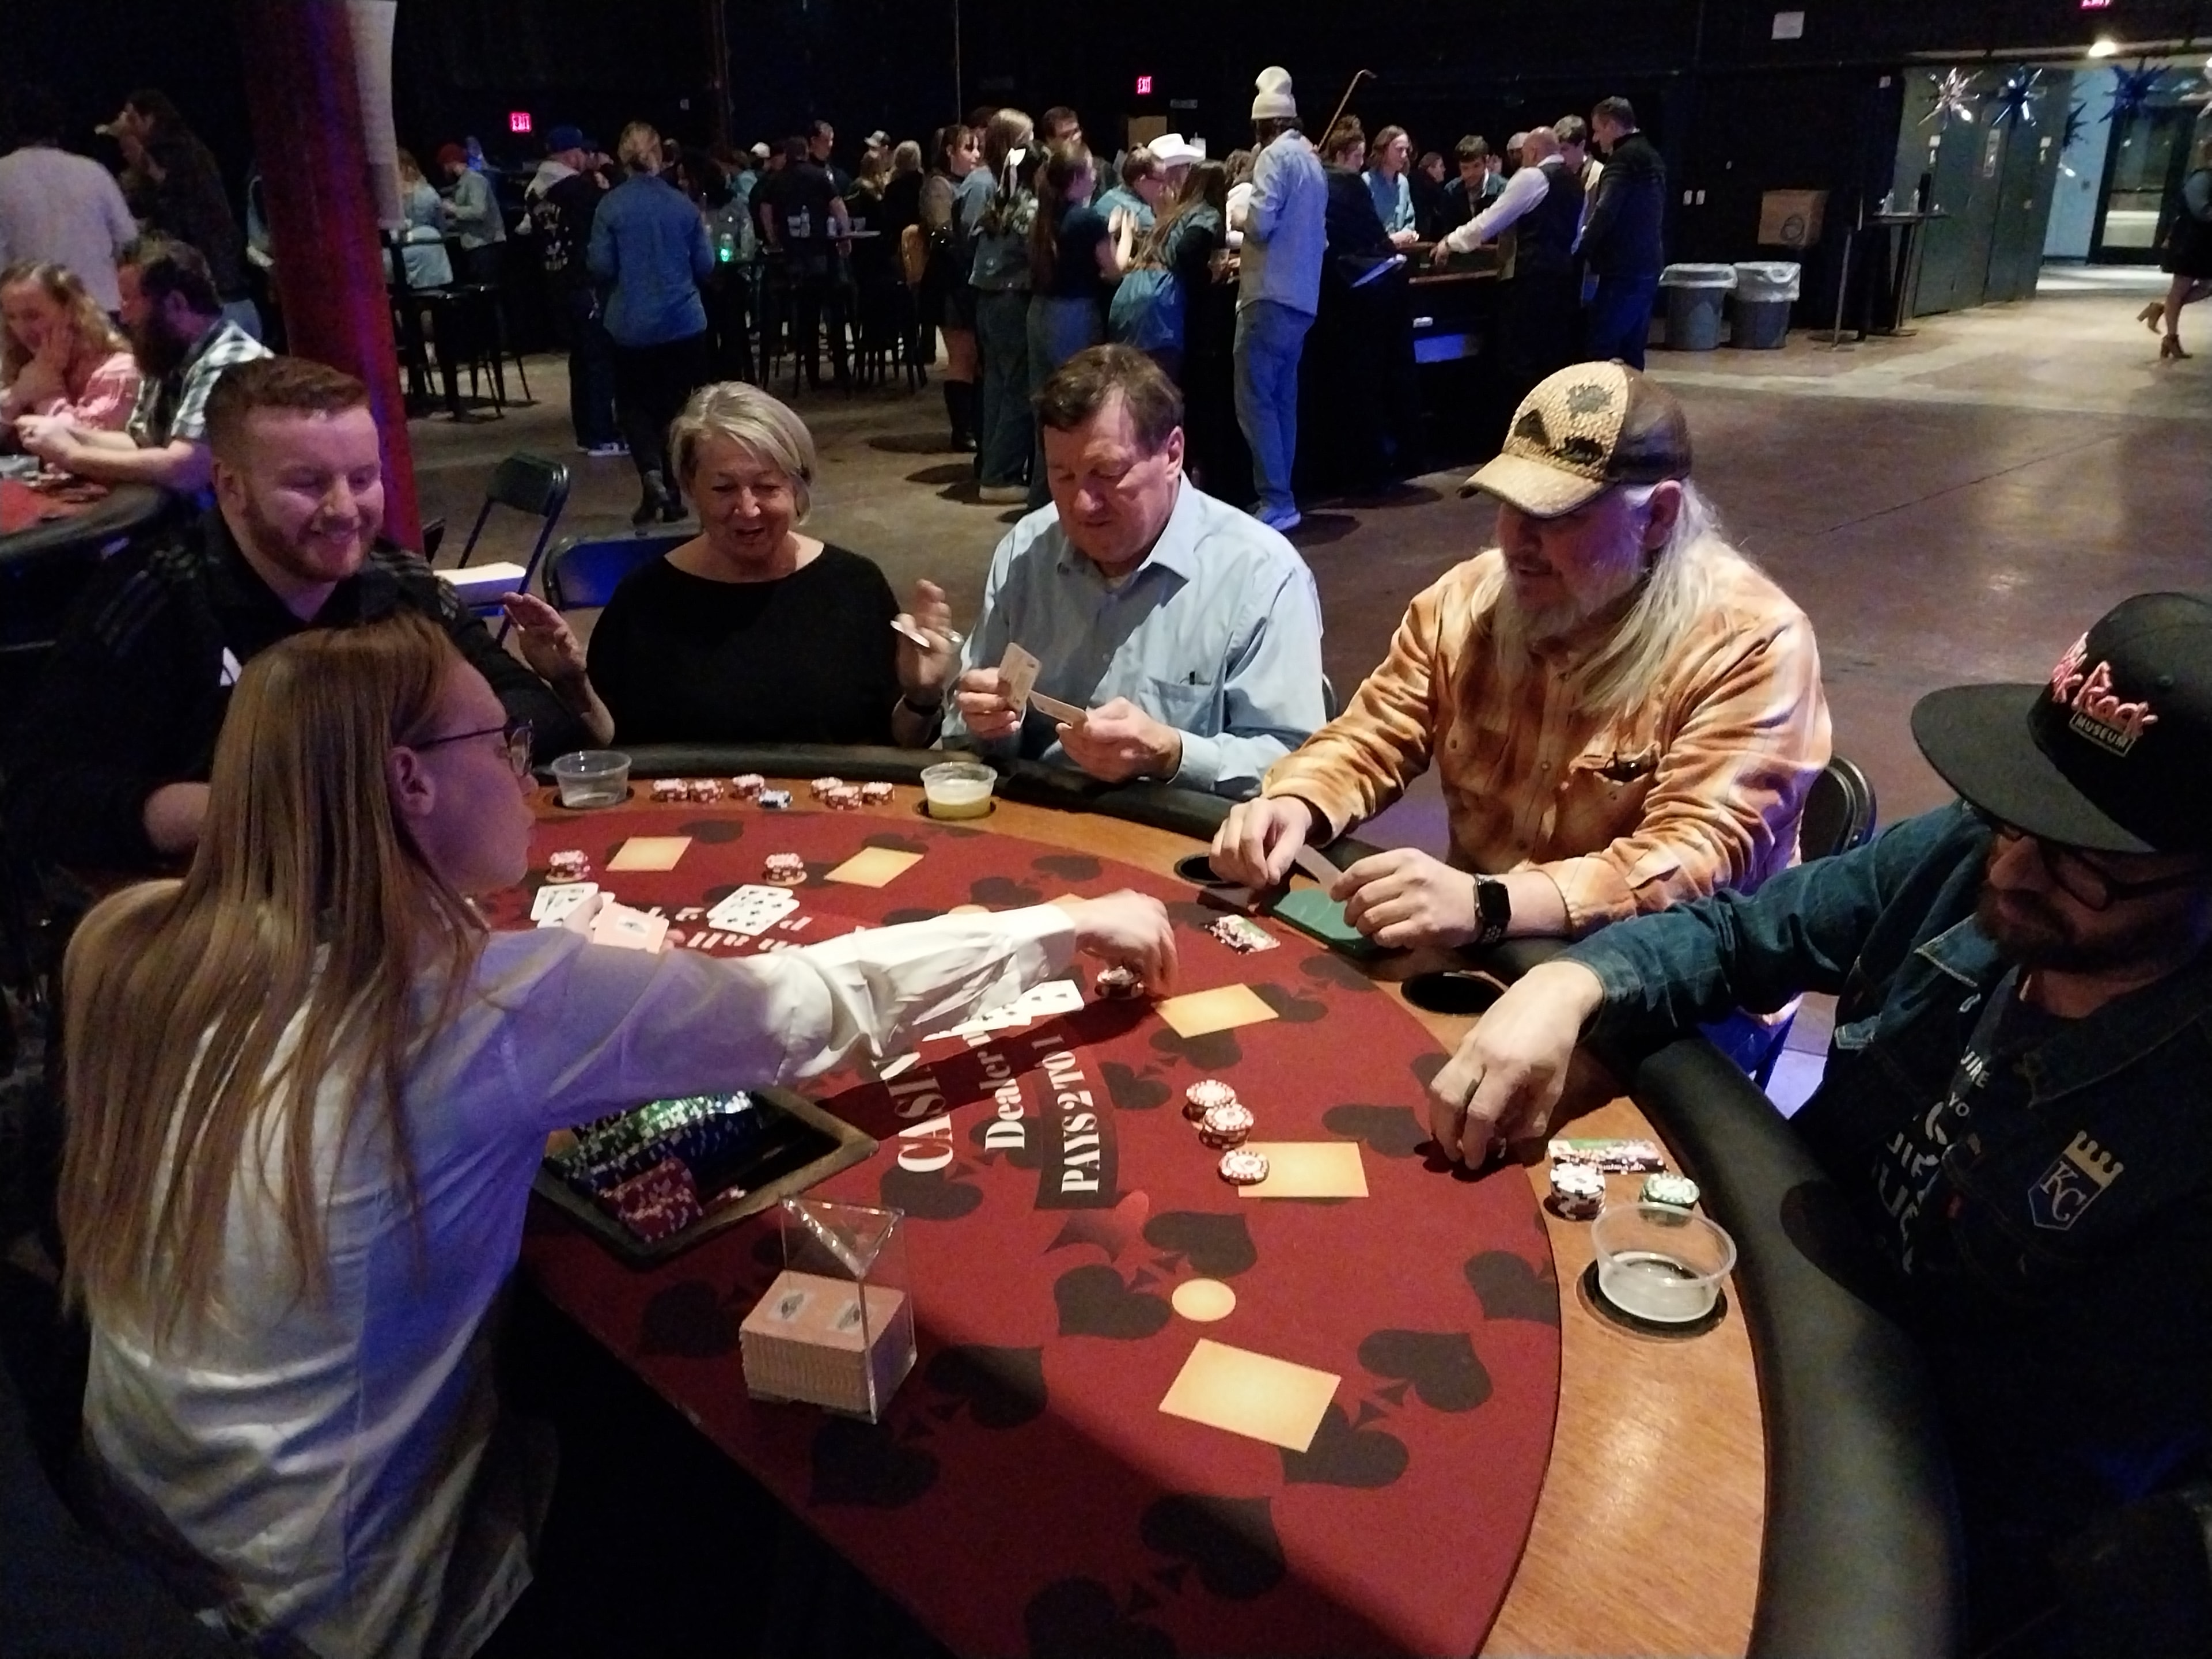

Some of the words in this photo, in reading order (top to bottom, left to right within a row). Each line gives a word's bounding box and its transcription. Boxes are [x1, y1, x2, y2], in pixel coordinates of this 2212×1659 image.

[2075, 713, 2130, 749] MUSEUM
[1040, 1050, 1085, 1089] TO
[1056, 1089, 1094, 1111] 2
[872, 1051, 954, 1173] CASIN
[978, 1051, 1025, 1152] Dealer
[1060, 1112, 1101, 1194] PAYS
[2038, 1159, 2088, 1222] KC
